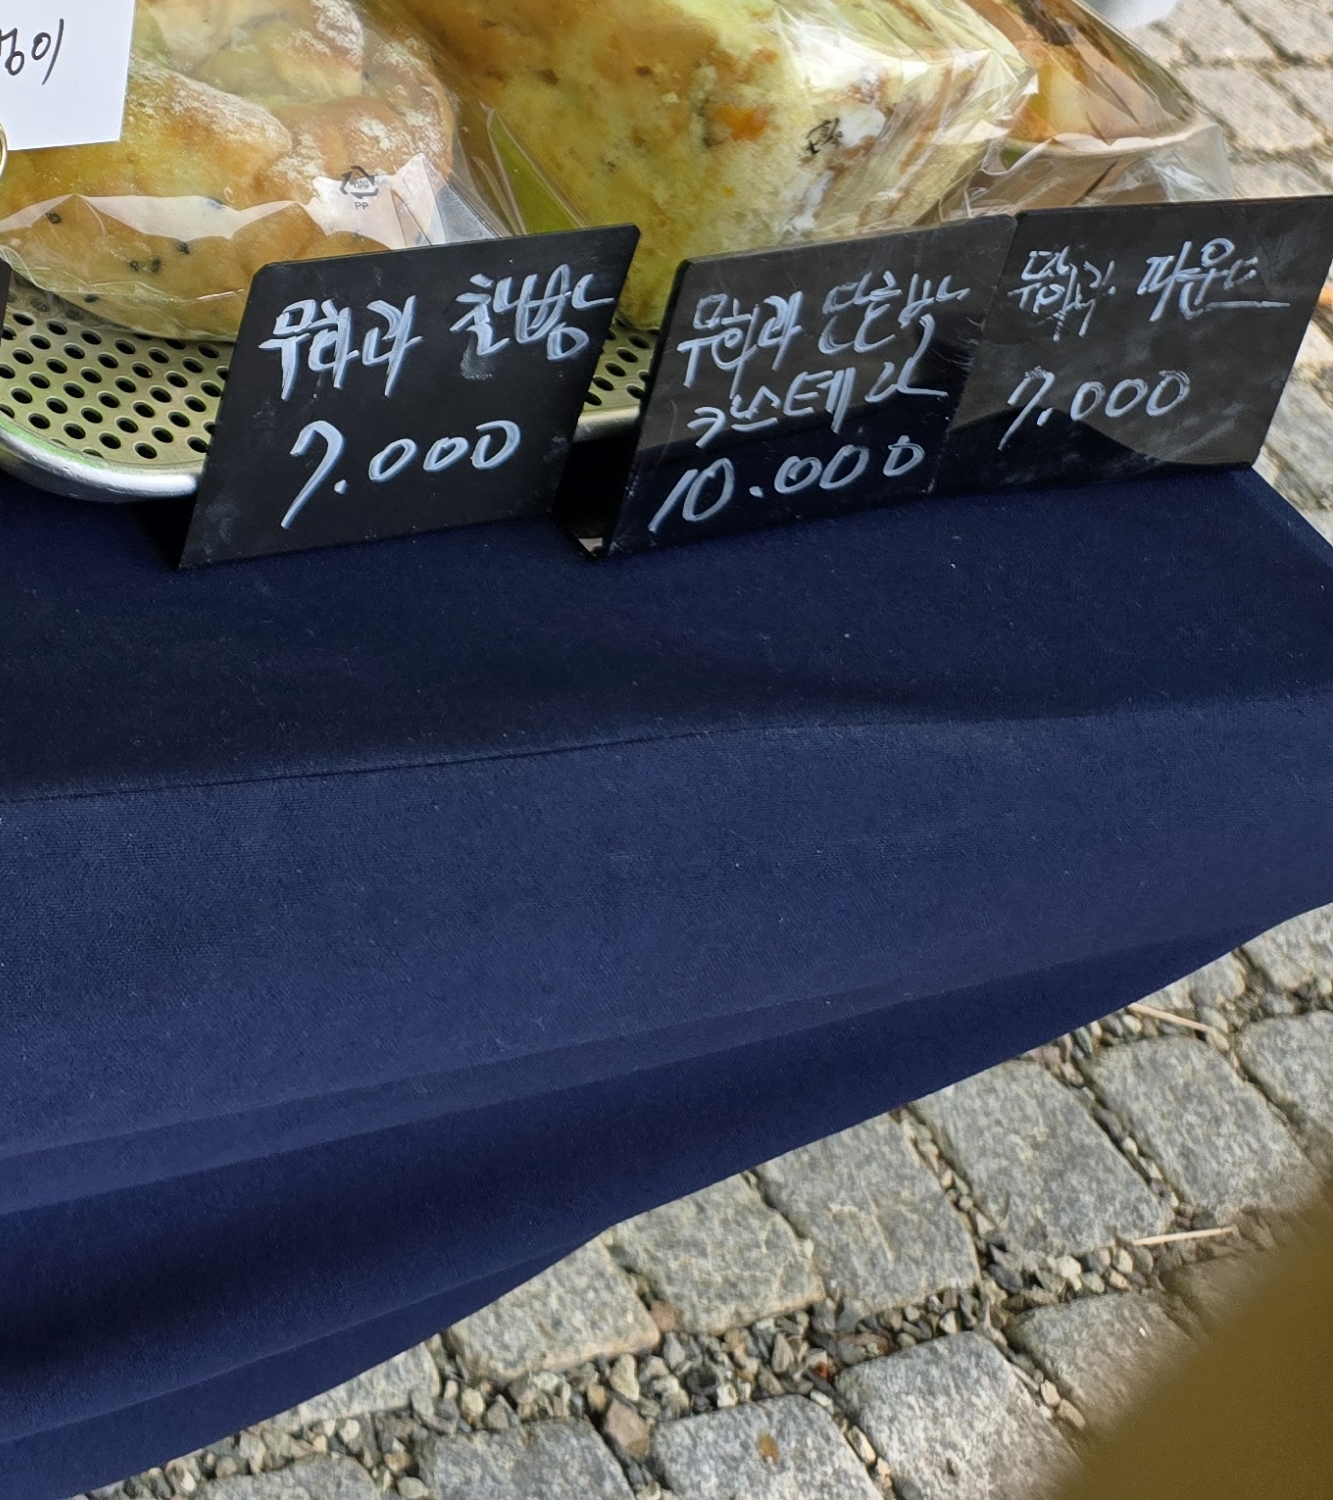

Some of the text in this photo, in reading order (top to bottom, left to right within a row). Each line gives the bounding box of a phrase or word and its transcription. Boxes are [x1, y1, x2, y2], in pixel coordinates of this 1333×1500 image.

[354, 202, 369, 211] PP
[258, 294, 423, 401] 무화과
[998, 365, 1191, 451] 7.000
[280, 419, 522, 530] 7.000
[649, 434, 925, 534] 10.000
